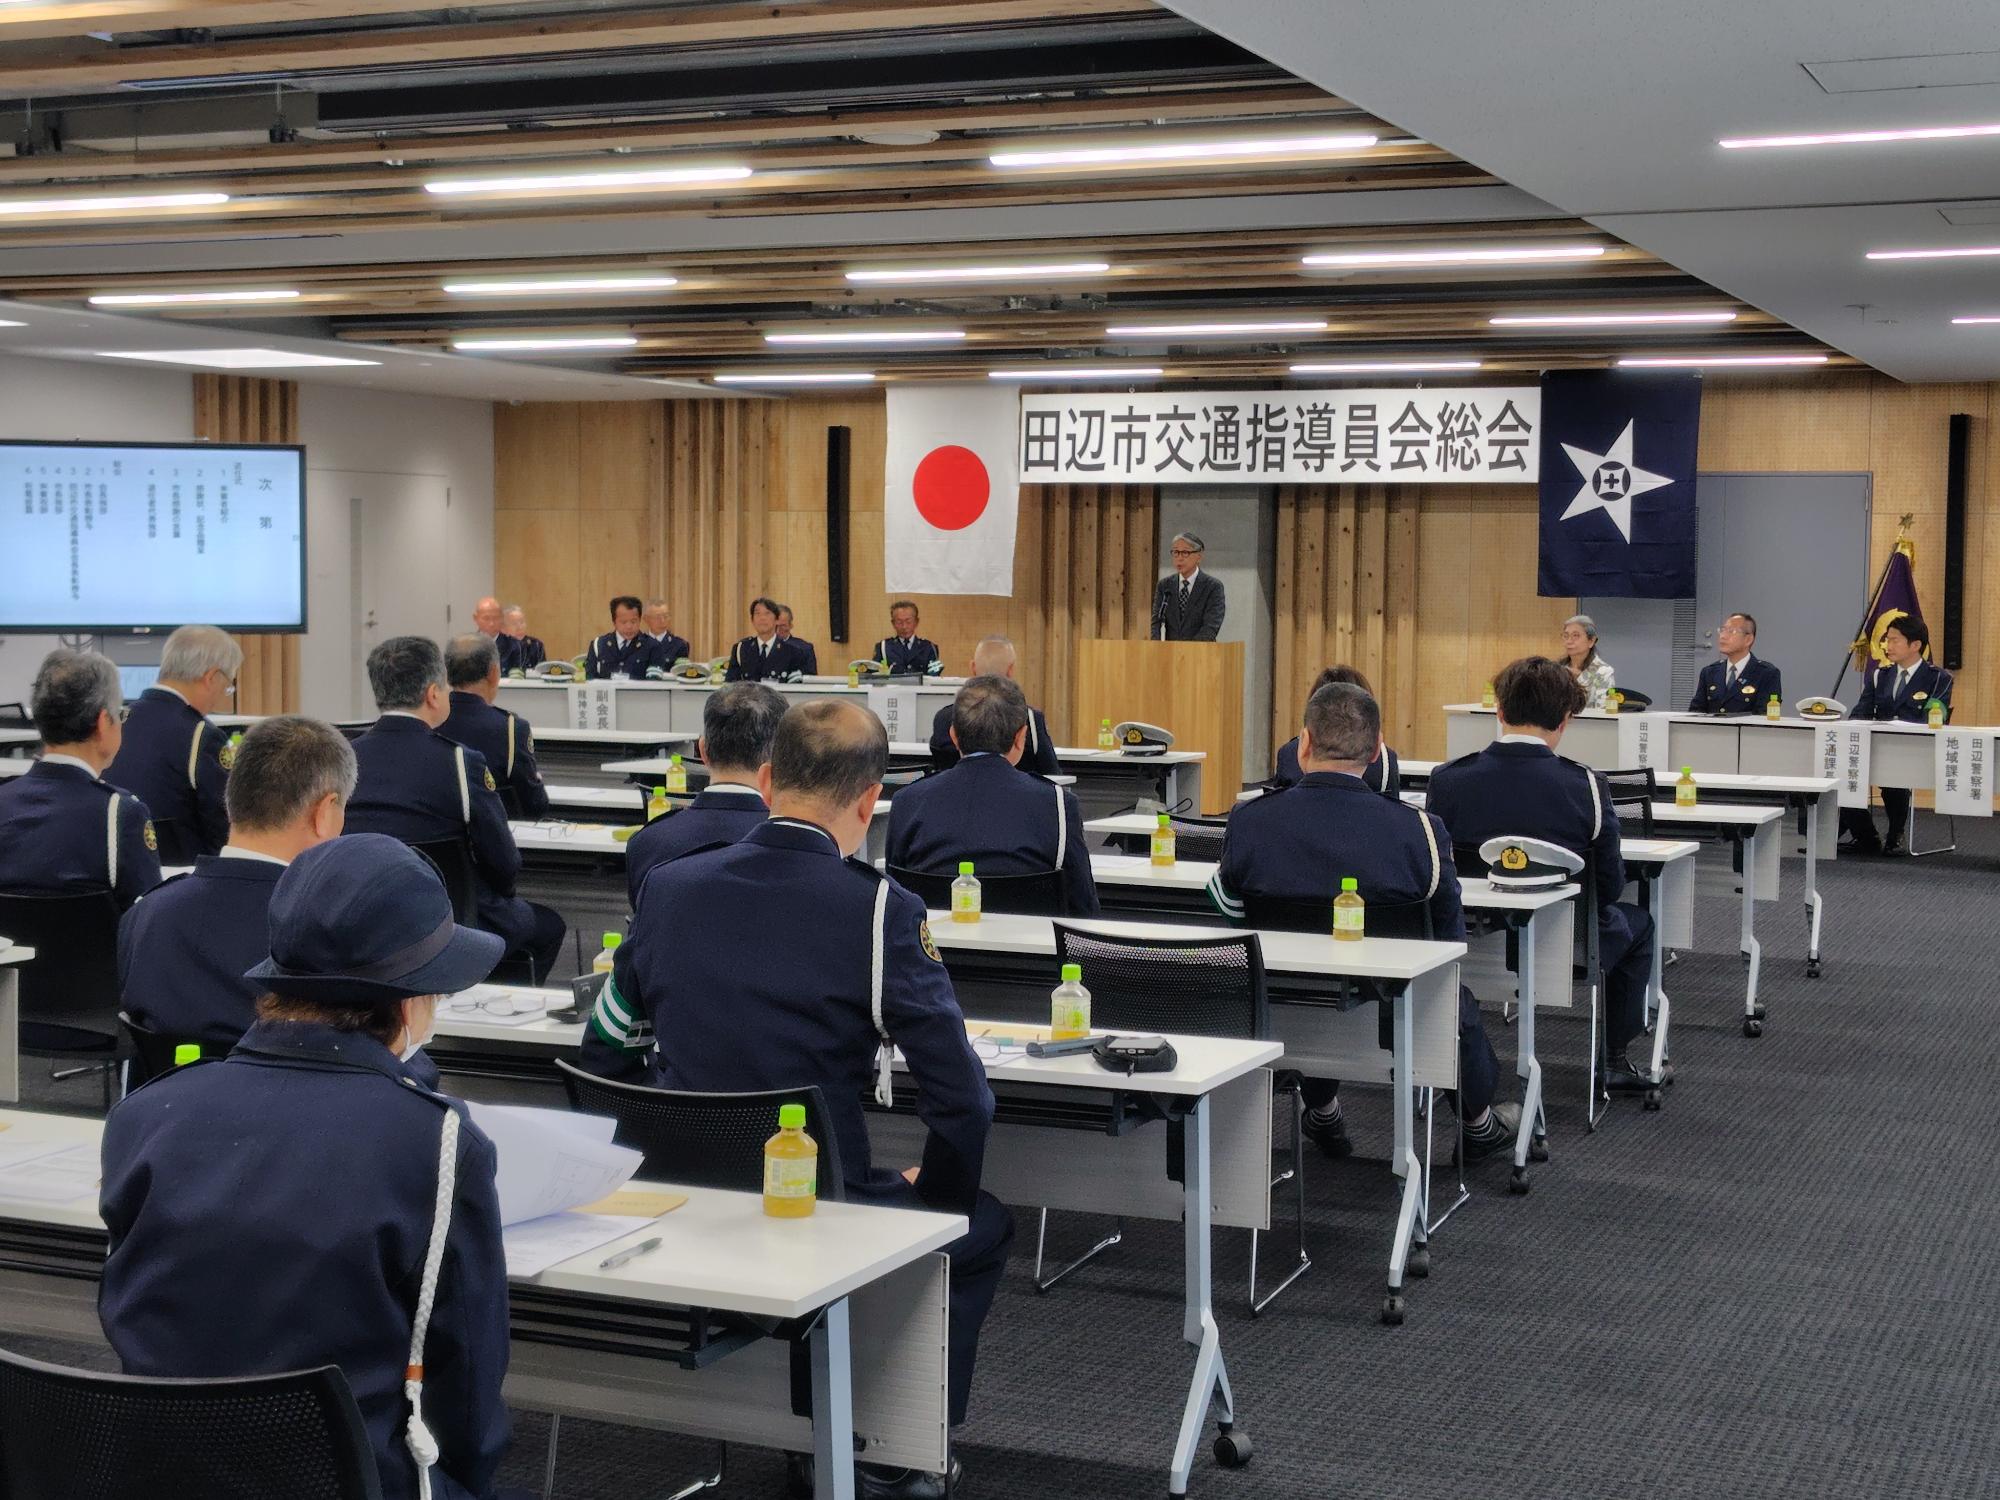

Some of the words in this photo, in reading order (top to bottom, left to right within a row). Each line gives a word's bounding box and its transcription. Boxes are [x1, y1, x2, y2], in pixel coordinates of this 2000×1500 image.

[1023, 400, 1533, 474] 田辺市交通指導員会総会
[597, 689, 608, 729] 副会長
[1848, 732, 1860, 792] 田辺警察署
[1945, 737, 1959, 792] 地域課長
[1969, 738, 1983, 801] 田辺警察署
